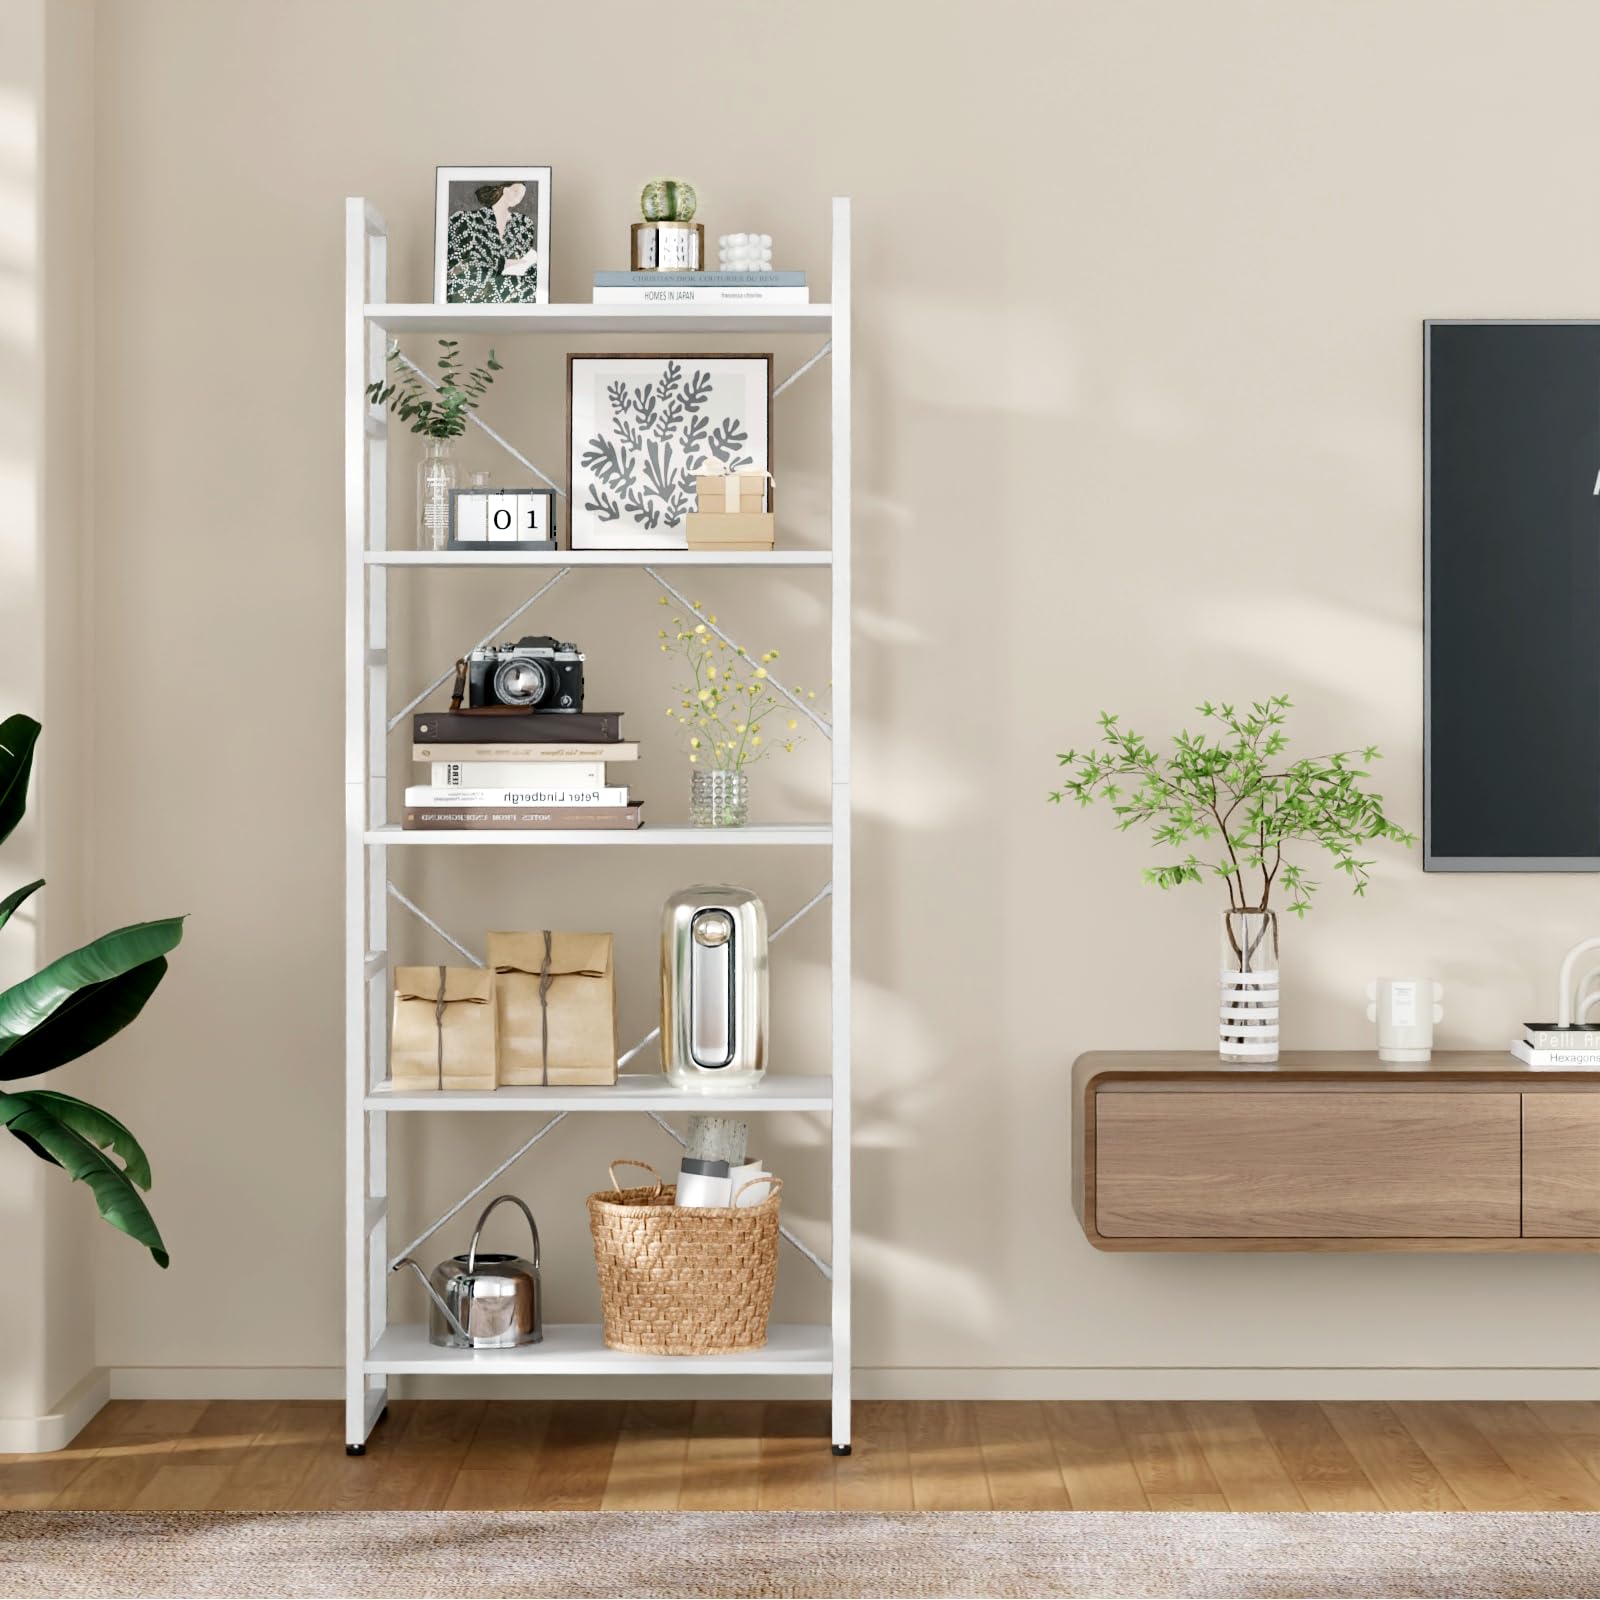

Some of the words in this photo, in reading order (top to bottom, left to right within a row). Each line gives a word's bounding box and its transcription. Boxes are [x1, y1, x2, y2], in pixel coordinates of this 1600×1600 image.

[644, 291, 667, 301] HOMES
[668, 291, 675, 301] IN
[676, 291, 695, 301] JAPAN
